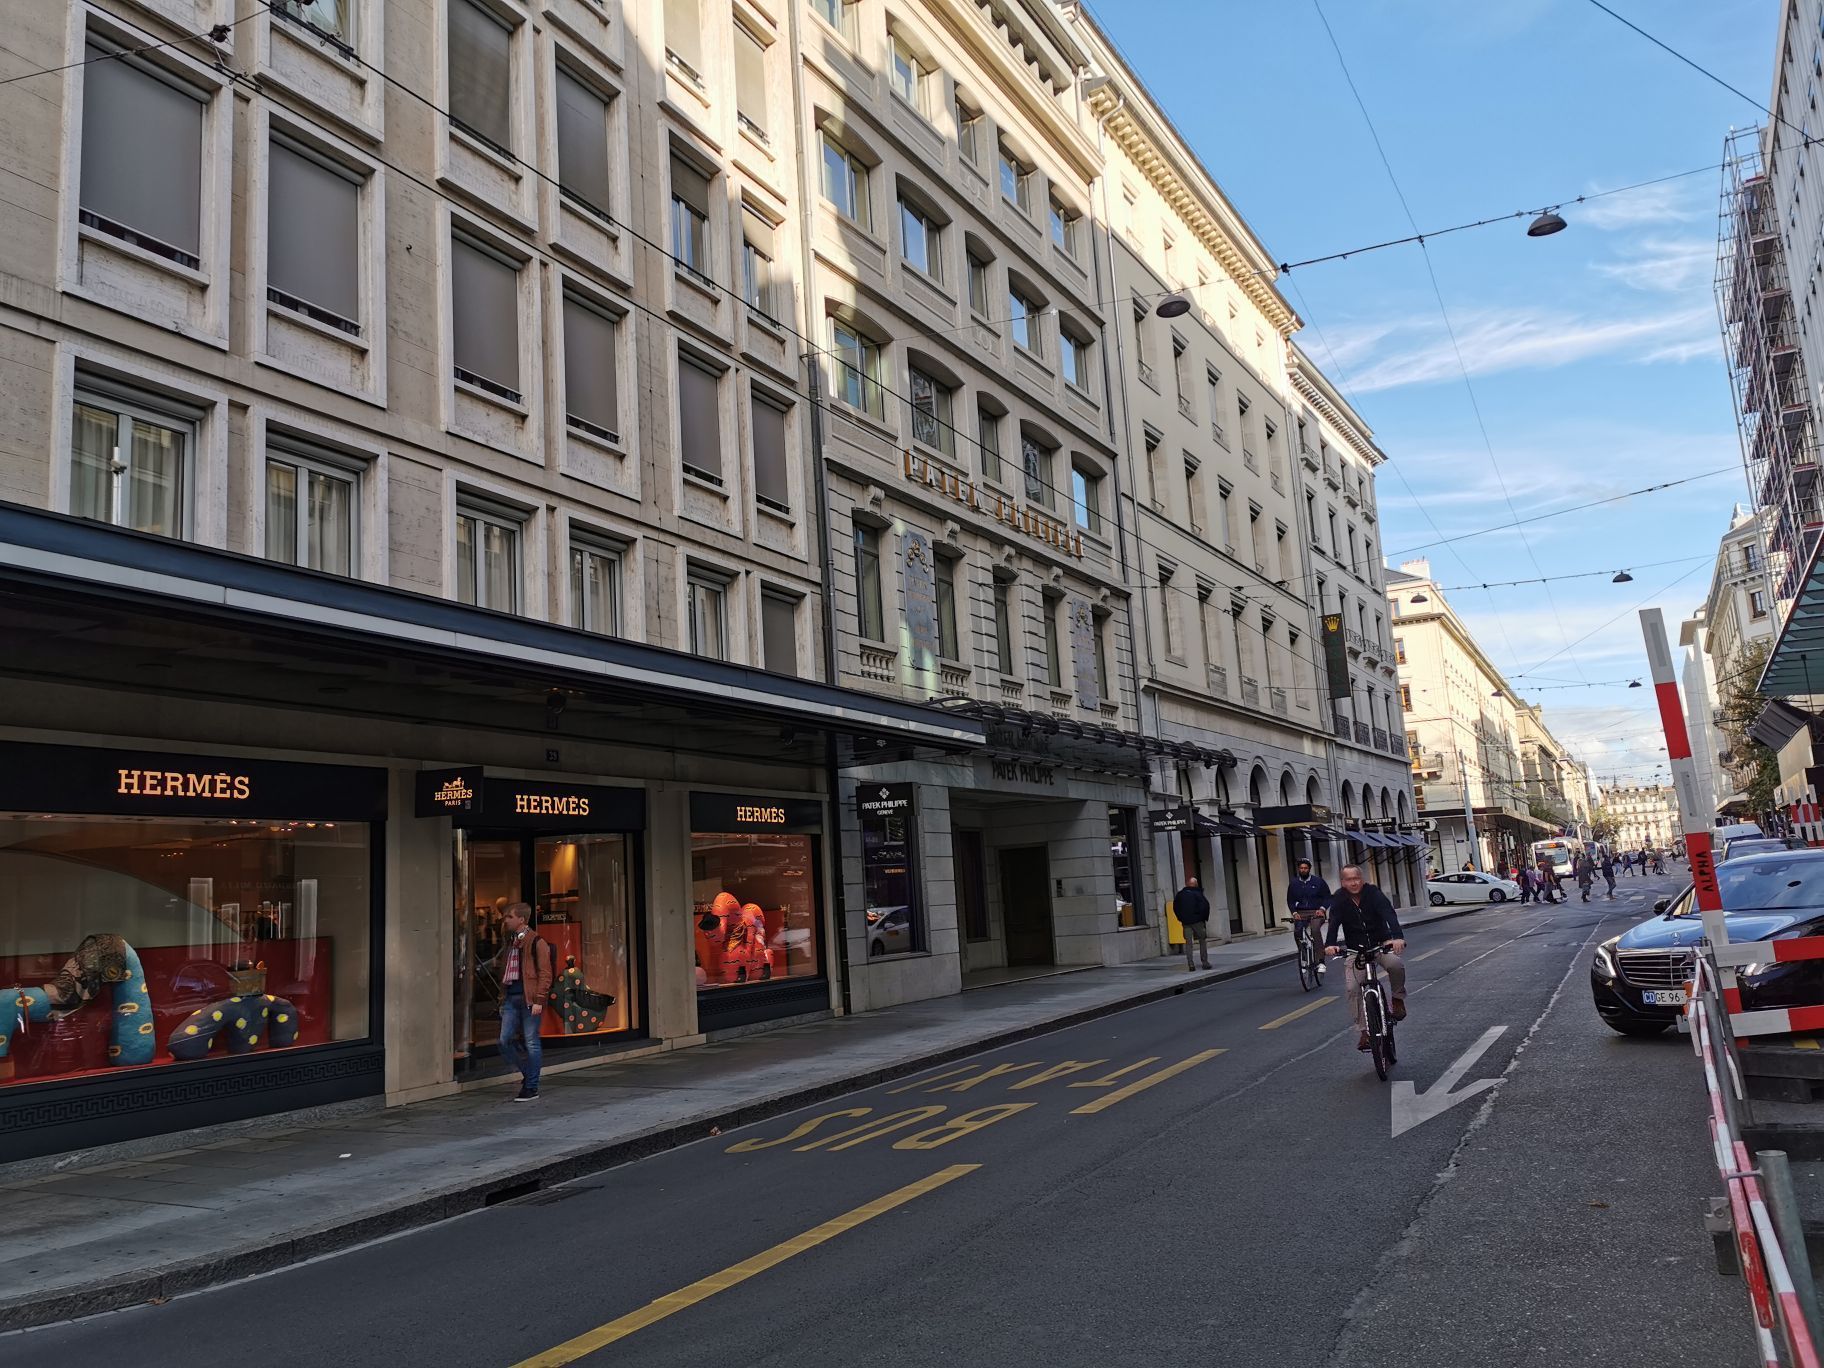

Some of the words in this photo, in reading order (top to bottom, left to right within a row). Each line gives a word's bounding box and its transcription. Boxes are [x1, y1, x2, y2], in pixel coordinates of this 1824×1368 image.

[992, 760, 1018, 781] PATEK
[117, 769, 250, 799] HERMÈS
[434, 788, 473, 801] HERMÈS
[515, 794, 590, 816] HERMÈS
[736, 806, 785, 823] HERMÈS
[862, 801, 881, 810] PATEK
[881, 799, 908, 809] PHILIPPE
[1695, 850, 1714, 892] ALPHA
[1644, 992, 1655, 1003] CD
[1656, 992, 1667, 1003] GE
[885, 1056, 1162, 1094] TAXI
[724, 1102, 1039, 1154] BUS
